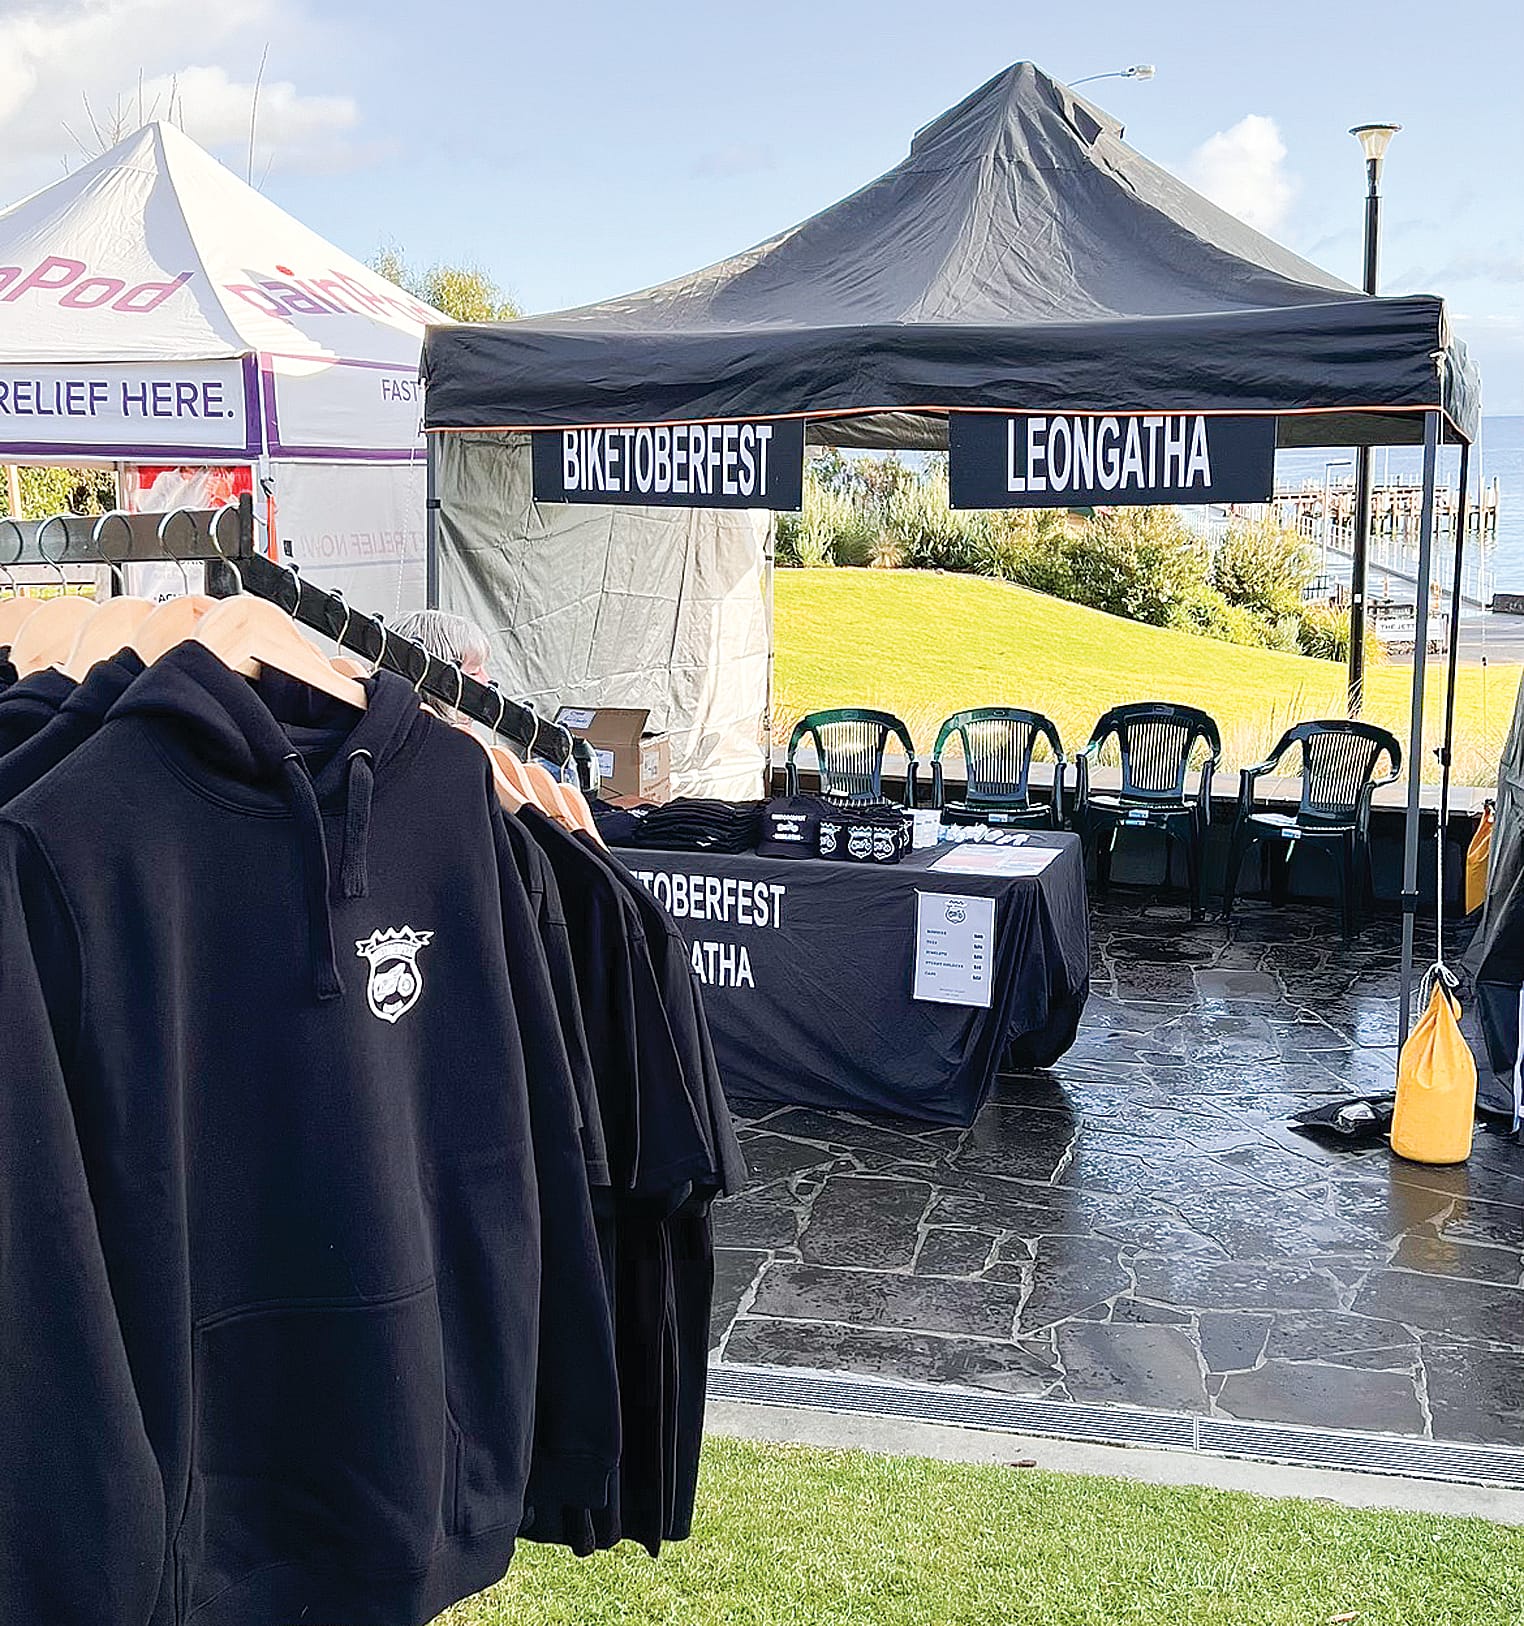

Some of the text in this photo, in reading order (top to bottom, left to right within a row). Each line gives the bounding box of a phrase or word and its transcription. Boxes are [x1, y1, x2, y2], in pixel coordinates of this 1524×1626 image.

[121, 382, 235, 418] HERE.
[381, 379, 419, 402] FAST
[563, 424, 773, 497] BIKETOBERFEST
[1007, 416, 1212, 492] LEONGATHA
[629, 870, 786, 929] TOBERFEST
